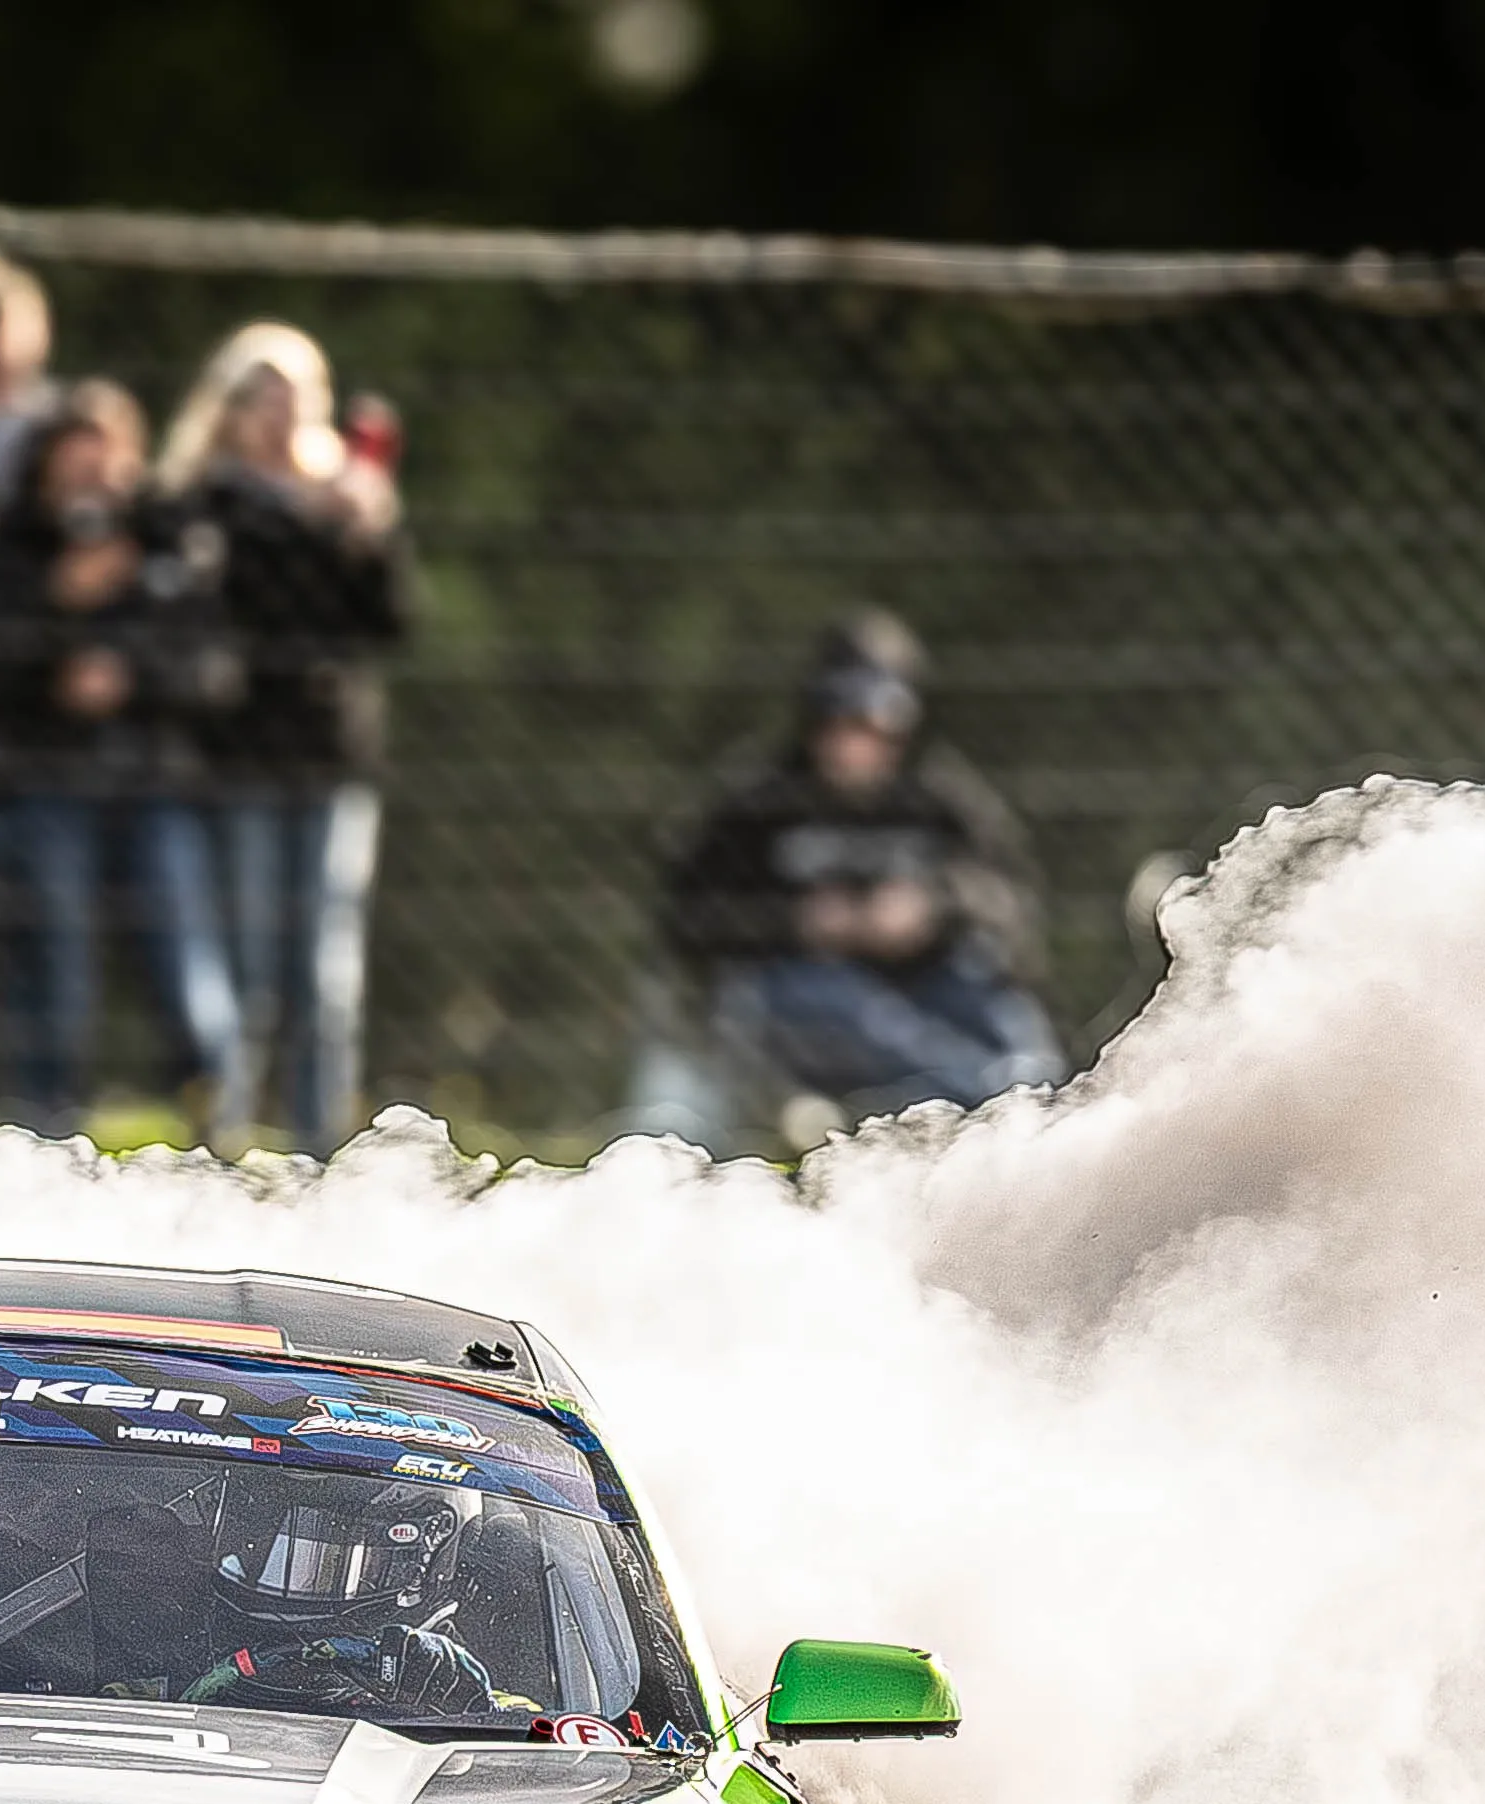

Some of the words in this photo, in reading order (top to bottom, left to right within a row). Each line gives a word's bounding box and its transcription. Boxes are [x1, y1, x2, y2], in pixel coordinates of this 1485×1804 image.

[317, 1398, 475, 1438] 130
[117, 1425, 253, 1450] HEATWAVE
[302, 1417, 489, 1448] SHOWDOWN
[397, 1454, 475, 1478] ECU
[392, 1527, 415, 1537] BELL
[575, 1723, 600, 1746] E
